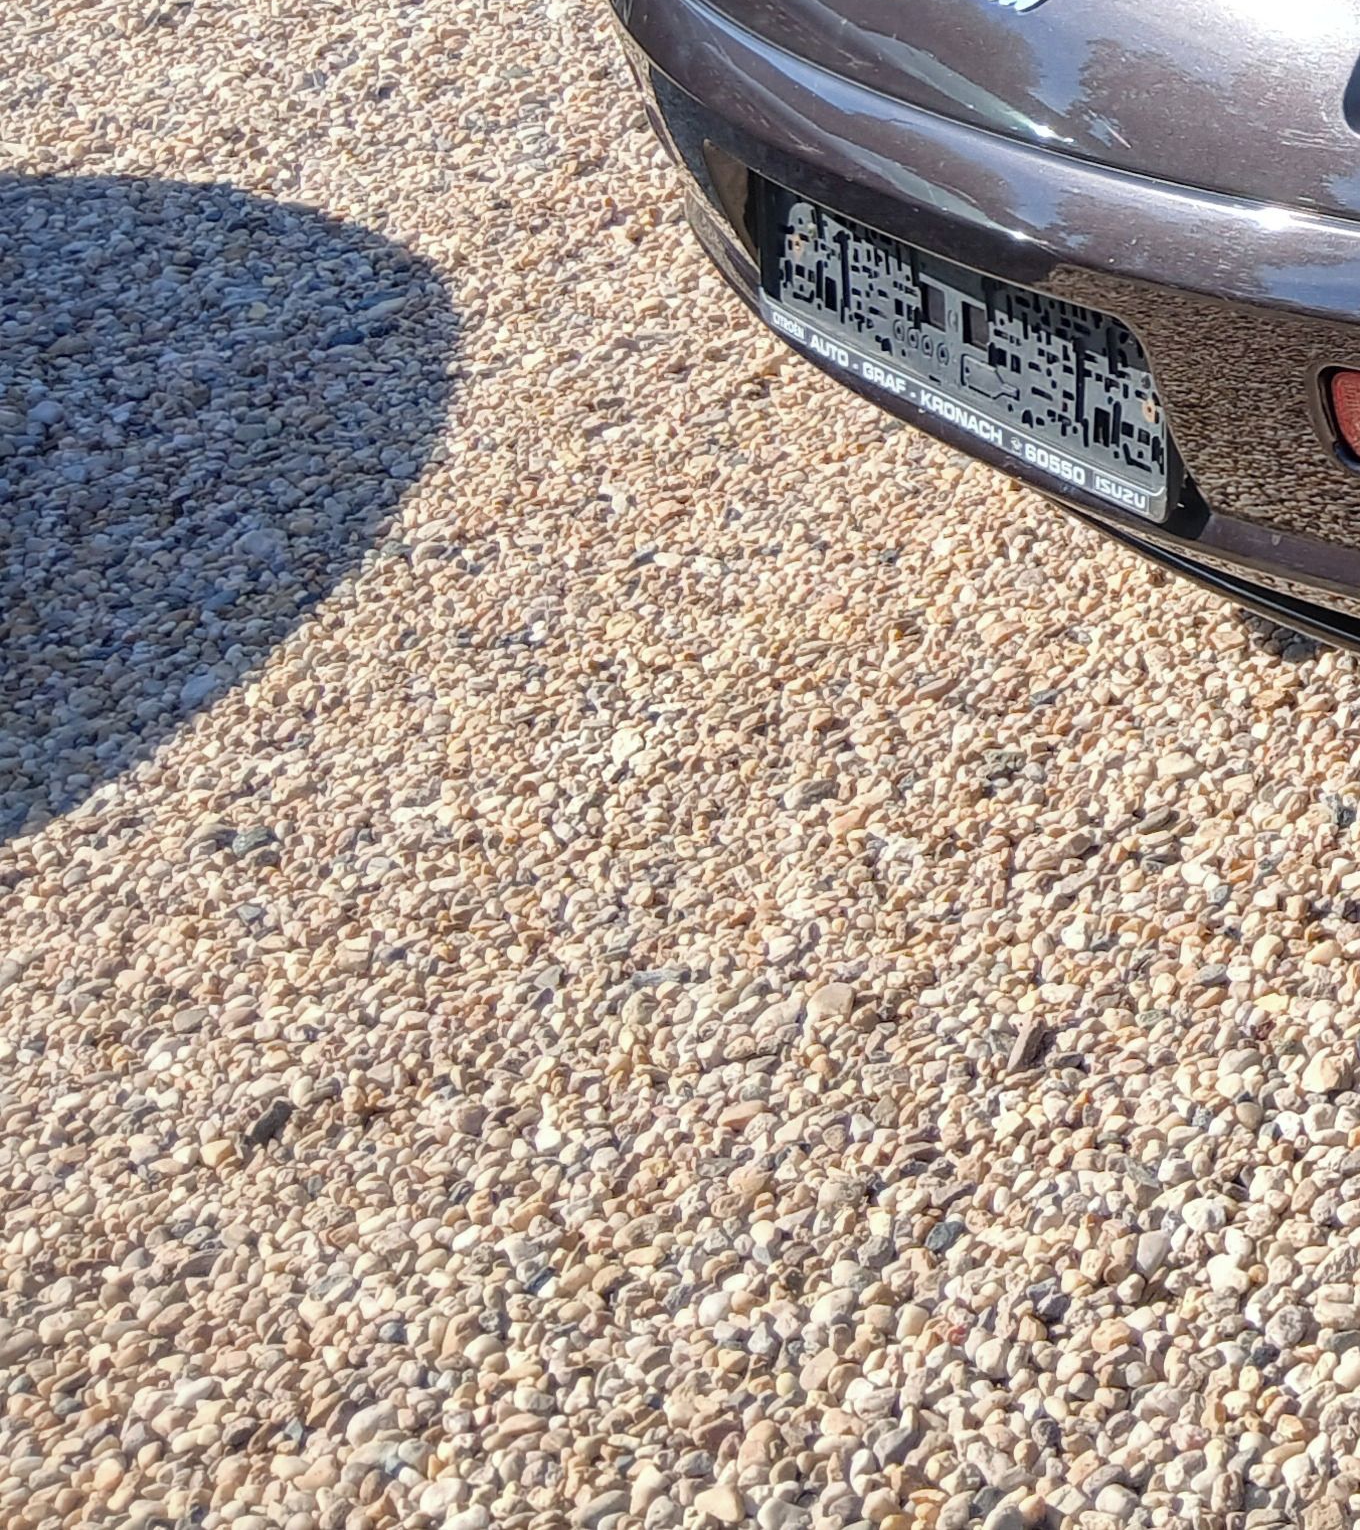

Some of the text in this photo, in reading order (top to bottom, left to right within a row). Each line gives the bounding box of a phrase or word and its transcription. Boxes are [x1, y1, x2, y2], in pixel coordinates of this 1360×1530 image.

[810, 334, 849, 368] AUTO
[862, 362, 907, 395] GRAF
[920, 389, 1003, 446] KRONACH
[1094, 475, 1147, 509] ISUZU
